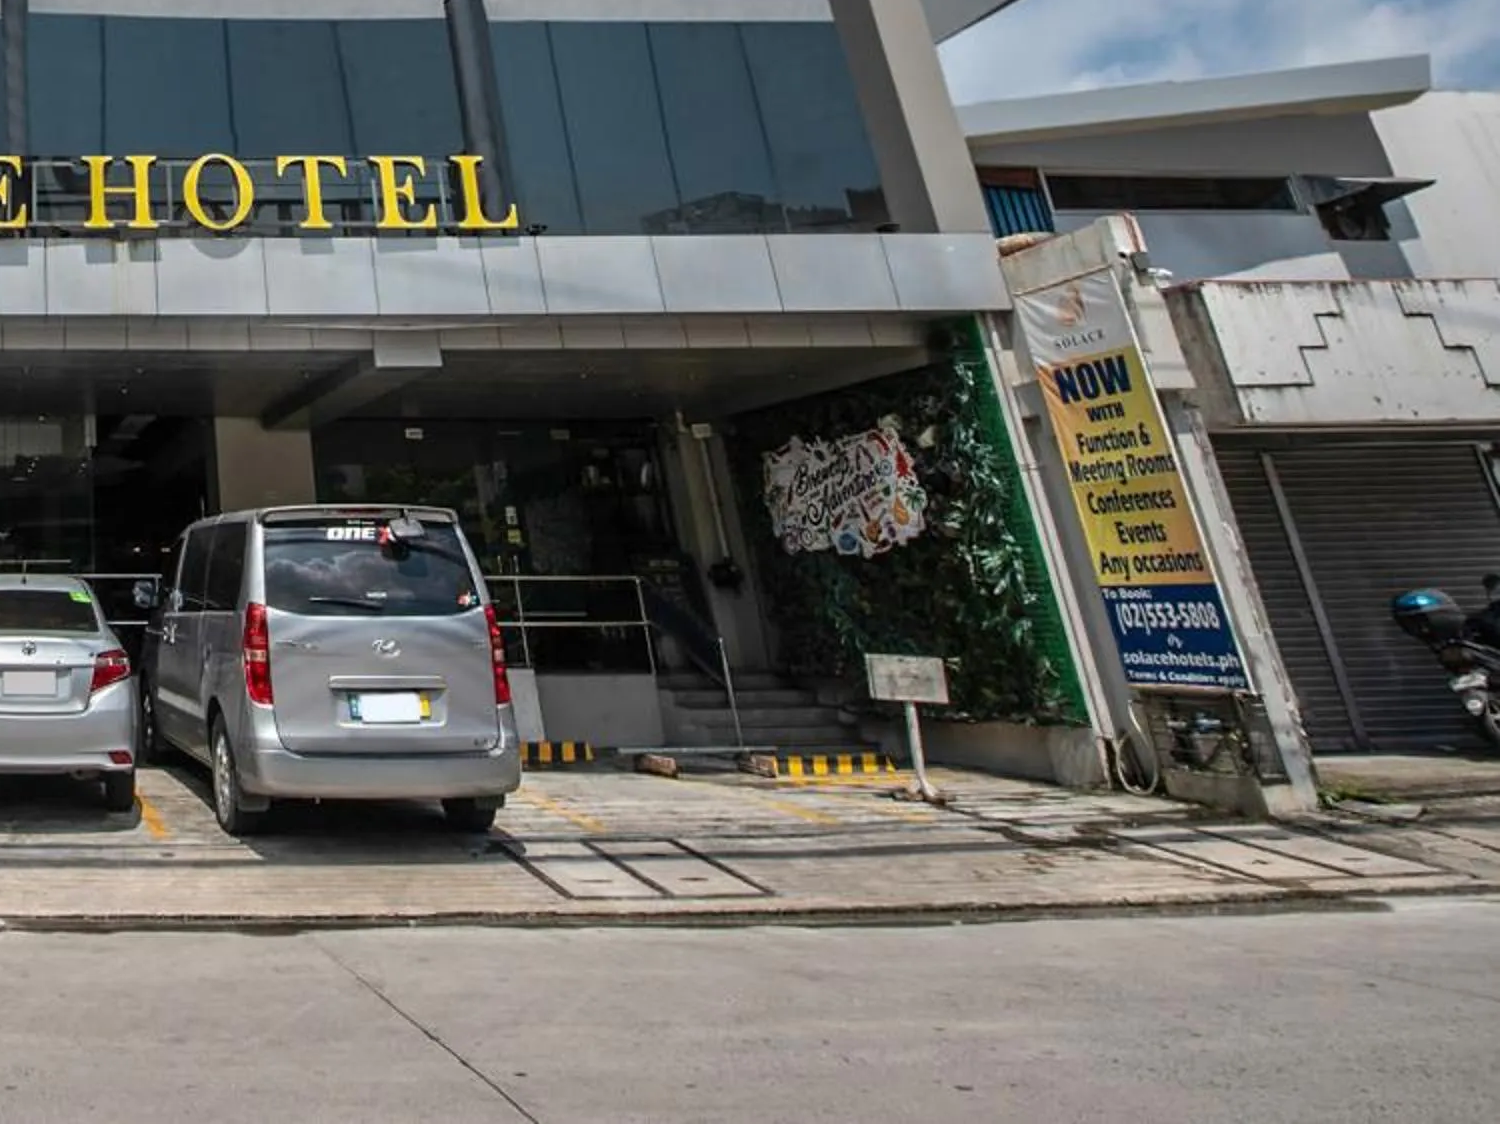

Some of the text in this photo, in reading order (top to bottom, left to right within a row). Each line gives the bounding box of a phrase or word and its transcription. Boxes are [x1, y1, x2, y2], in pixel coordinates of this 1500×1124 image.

[80, 153, 518, 230] HOTEL
[1054, 328, 1105, 350] SOLACE
[1054, 354, 1132, 405] NOW
[1086, 402, 1125, 423] WITH
[1076, 422, 1151, 455] Function &
[1070, 453, 1176, 485] Meeting Rooms
[1086, 488, 1176, 515] Conferences
[1114, 521, 1167, 544] Events
[1100, 548, 1204, 581] Any occasions
[1102, 589, 1117, 599] To
[1123, 649, 1240, 672] solacehotels.ph
